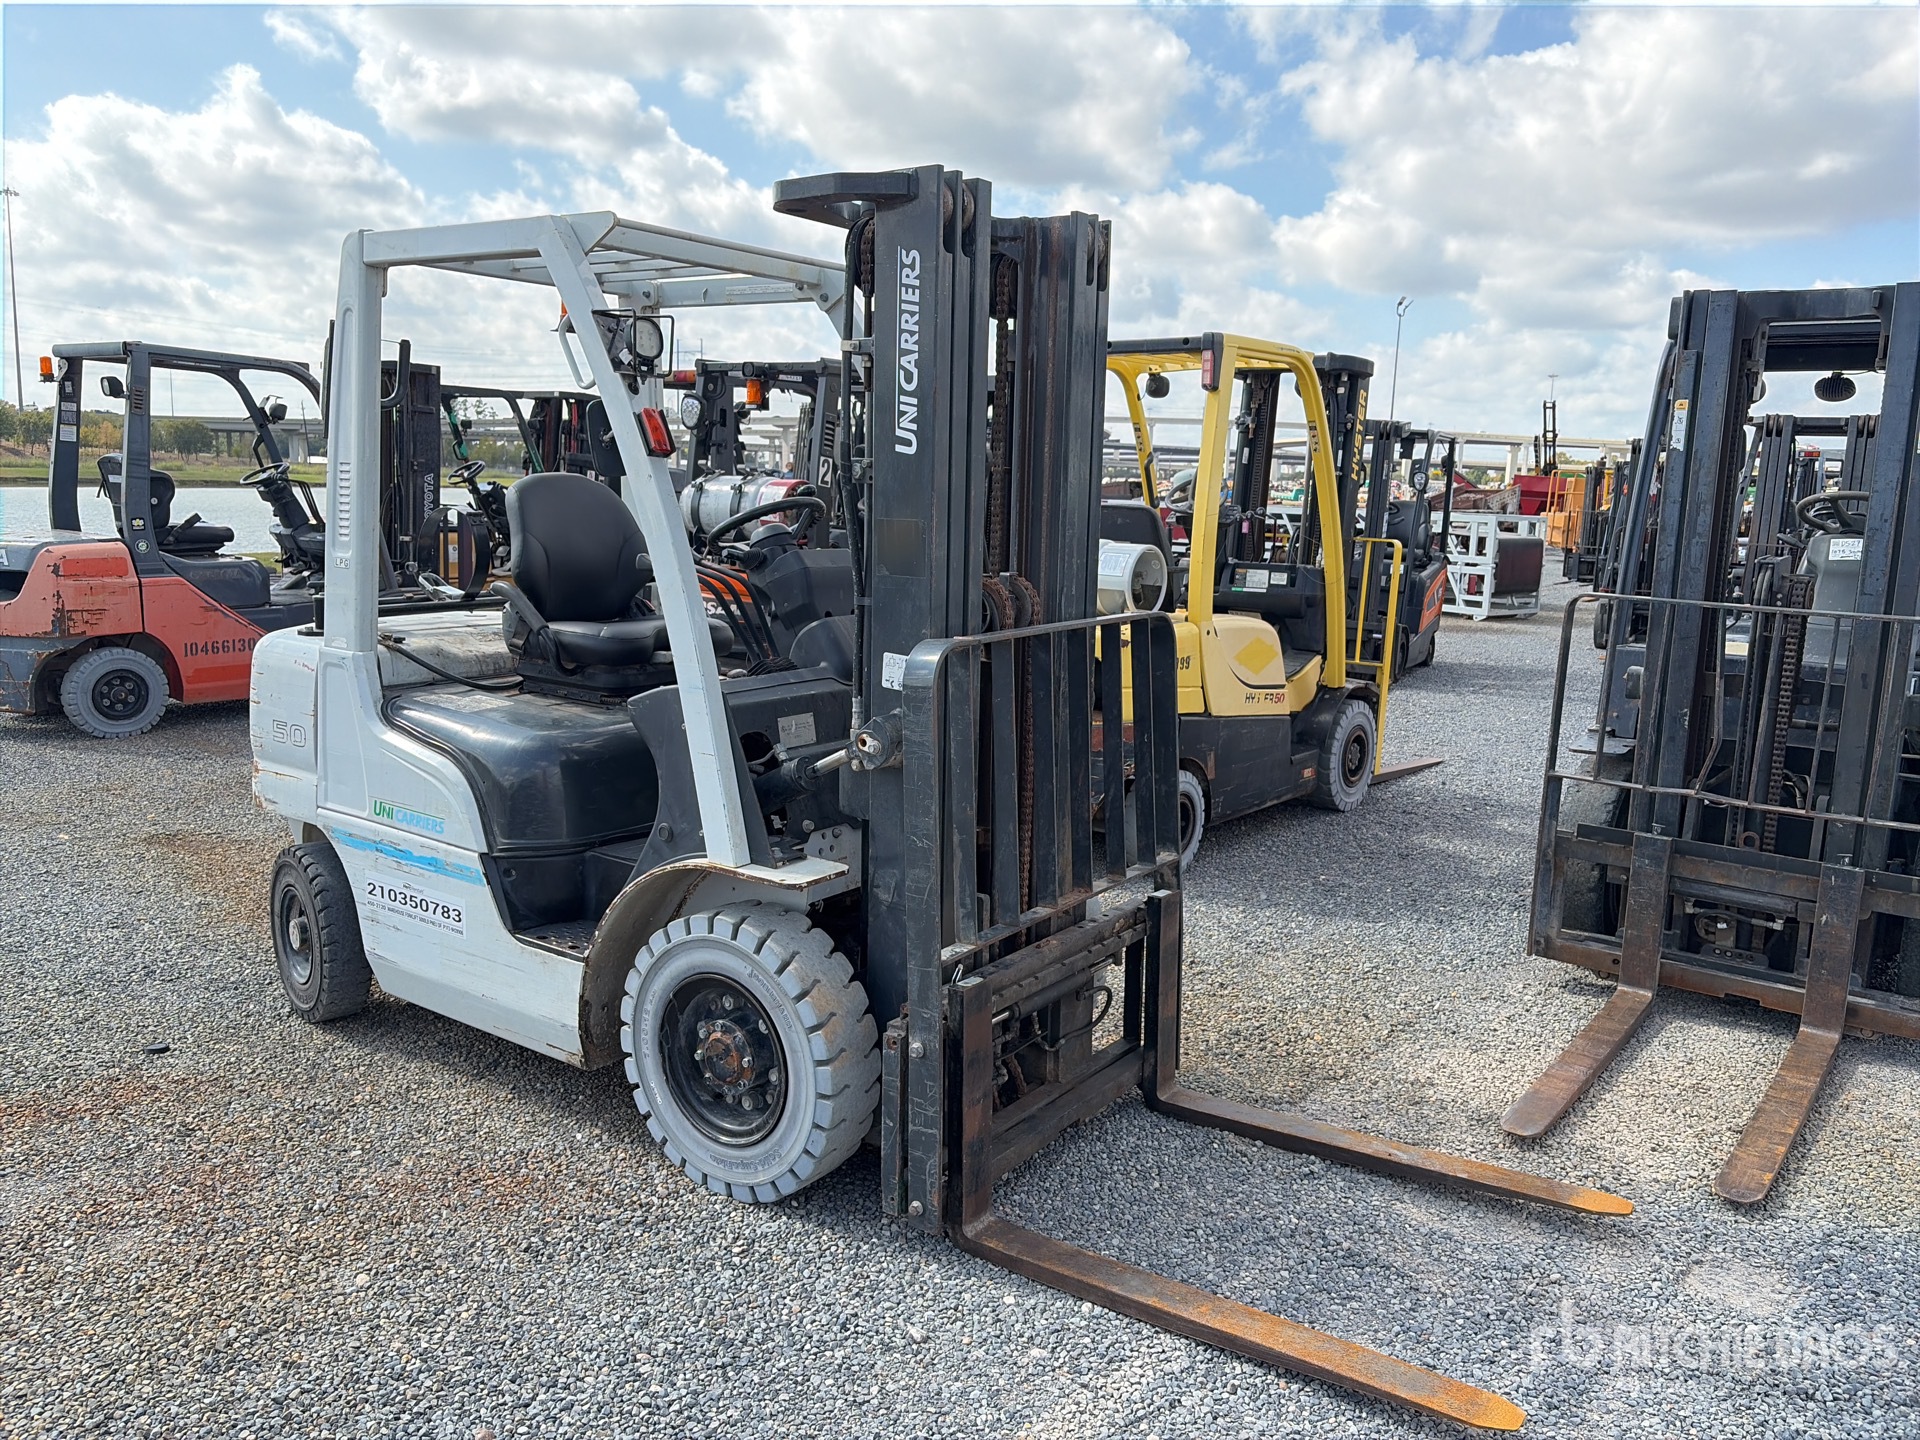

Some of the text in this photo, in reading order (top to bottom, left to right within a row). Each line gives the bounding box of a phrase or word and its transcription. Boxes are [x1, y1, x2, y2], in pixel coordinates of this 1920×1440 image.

[1351, 389, 1367, 481] HYSTER
[424, 473, 434, 520] OYOTA
[335, 558, 349, 567] LPG
[183, 638, 256, 658] 10466130
[272, 719, 307, 748] 50
[367, 882, 462, 923] 210350783
